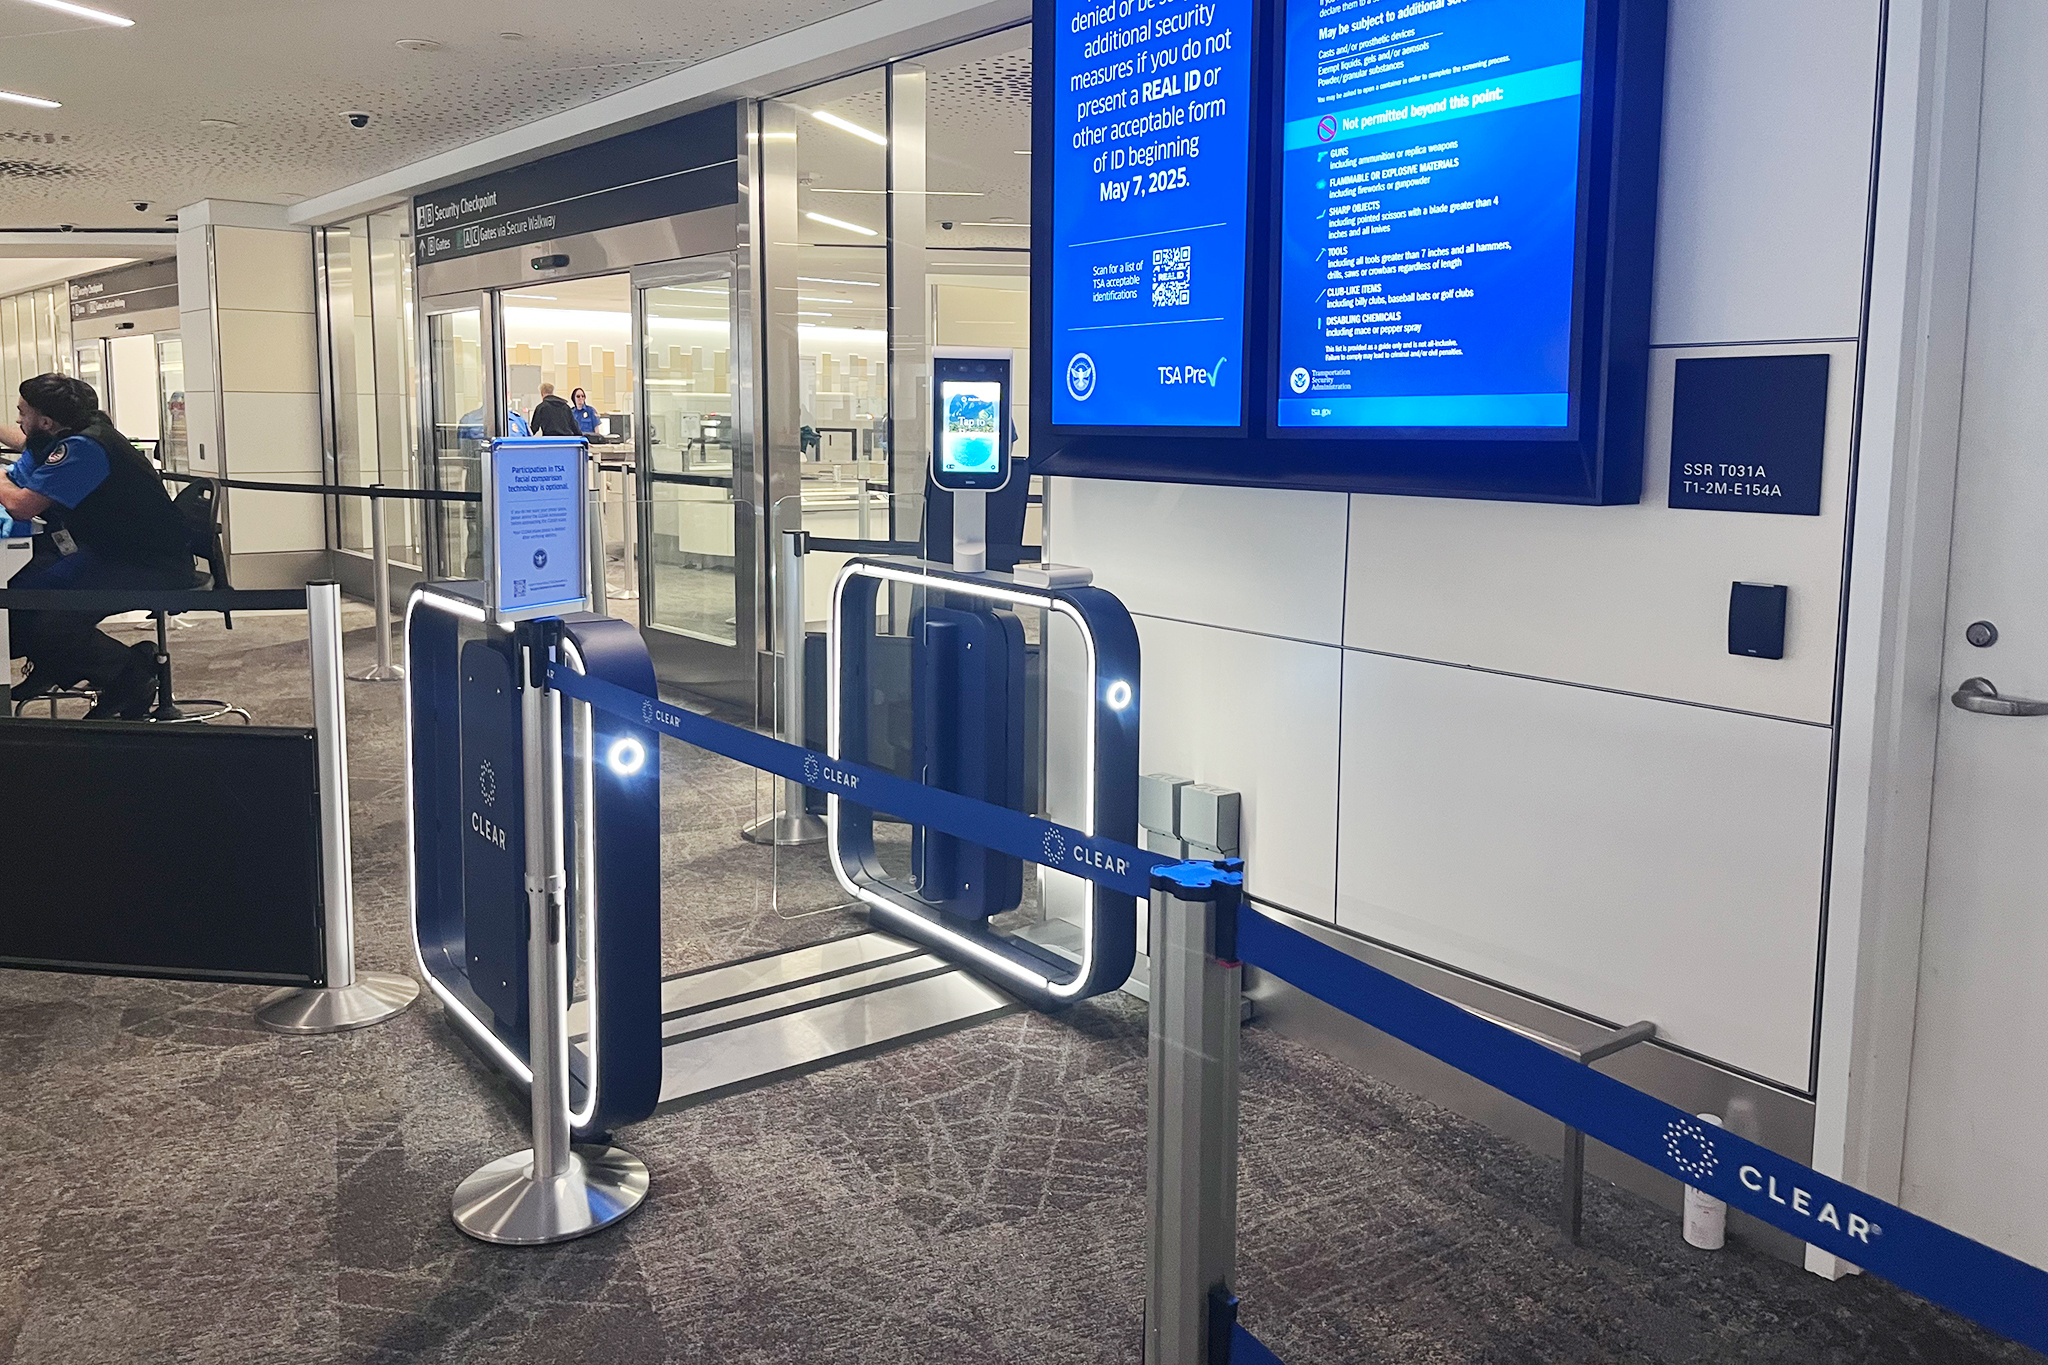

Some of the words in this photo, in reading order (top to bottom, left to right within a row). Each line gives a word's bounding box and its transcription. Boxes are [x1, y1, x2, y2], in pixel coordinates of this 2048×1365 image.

[1071, 0, 1115, 33] denied
[1119, 0, 1134, 18] or
[1319, 5, 1341, 18] declare
[1342, 1, 1358, 12] them
[1319, 27, 1337, 40] May
[1338, 23, 1350, 35] be
[1351, 12, 1384, 31] subject
[1385, 10, 1395, 22] to
[1397, 0, 1445, 19] additional
[1084, 18, 1151, 58] additional
[1155, 4, 1216, 38] security
[1318, 49, 1335, 59] Casts
[1336, 43, 1358, 55] and/or
[1358, 34, 1390, 51] prosthetic
[1391, 28, 1416, 41] devices
[1070, 59, 1133, 92] measures
[1137, 51, 1148, 74] if
[1150, 48, 1178, 73] you
[1181, 38, 1201, 61] do
[1205, 28, 1232, 56] not
[1317, 63, 1340, 76] Exempt
[1340, 58, 1363, 71] liquids,
[1363, 54, 1377, 66] gels
[1377, 49, 1401, 61] and/or
[1401, 41, 1430, 56] aerosols
[1317, 69, 1368, 87] Powder/granular
[1368, 60, 1405, 76] substances
[1077, 88, 1128, 122] present
[1130, 89, 1139, 105] a
[1142, 75, 1181, 103] REAL
[1184, 69, 1201, 93] ID
[1204, 67, 1222, 87] or
[1342, 116, 1359, 131] Not
[1361, 106, 1408, 130] permitted
[1410, 98, 1447, 118] beyond
[1449, 94, 1470, 110] this
[1472, 86, 1504, 109] point:
[1073, 124, 1108, 149] other
[1110, 105, 1185, 140] acceptable
[1188, 98, 1226, 123] form
[1093, 151, 1108, 173] of
[1110, 149, 1125, 170] ID
[1128, 136, 1200, 167] beginning
[1329, 158, 1357, 170] including
[1358, 151, 1396, 165] ammunition
[1396, 150, 1404, 158] or
[1404, 145, 1427, 157] replica
[1427, 140, 1459, 152] weapons
[1330, 146, 1349, 158] GUNS
[1329, 172, 1370, 187] FLAMMABLE
[1370, 170, 1381, 180] OR
[1381, 164, 1418, 179] EXPLOSIVE
[1419, 157, 1459, 173] MATERIALS
[1100, 180, 1130, 202] May
[1132, 175, 1146, 198] 7,
[1149, 166, 1190, 194] 2025.
[1329, 187, 1357, 199] including
[1357, 183, 1385, 195] fireworks
[1386, 182, 1394, 190] or
[1394, 176, 1431, 191] gunpowder
[434, 202, 460, 221] Security
[460, 191, 498, 214] Checkpoint
[1328, 205, 1351, 217] SHARP
[1351, 200, 1380, 213] OBJECTS
[1328, 217, 1356, 228] including
[1356, 213, 1380, 226] pointed
[1381, 210, 1407, 221] scissors
[1407, 207, 1422, 217] with
[1422, 207, 1428, 216] a
[1428, 203, 1448, 214] blade
[1449, 201, 1474, 214] greater
[1475, 198, 1492, 208] than
[1492, 195, 1499, 206] 4
[479, 227, 497, 242] Gates
[497, 224, 506, 237] via
[506, 220, 528, 236] Secure
[527, 215, 556, 230] Walkway
[1328, 230, 1348, 240] inches
[1348, 226, 1361, 237] and
[1362, 225, 1370, 235] all
[1370, 224, 1391, 234] knives
[435, 237, 451, 251] Gates
[1327, 246, 1348, 257] TOOLS
[1327, 258, 1355, 268] including
[1355, 256, 1364, 266] all
[1364, 254, 1381, 264] tools
[1381, 252, 1405, 265] greater
[1404, 250, 1420, 260] than
[1421, 248, 1427, 258] 7
[1427, 247, 1450, 258] inches
[1450, 244, 1465, 255] and
[1465, 243, 1475, 254] all
[1475, 241, 1512, 253] hammers,
[1092, 265, 1108, 276] Scan
[1108, 263, 1118, 274] for
[1119, 265, 1124, 273] a
[1124, 261, 1135, 273] list
[1135, 259, 1144, 271] of
[1327, 270, 1344, 280] drills,
[1344, 269, 1360, 279] saws
[1360, 268, 1368, 277] or
[1368, 265, 1397, 276] crowbars
[1397, 262, 1431, 275] regardless
[1432, 259, 1440, 270] of
[1440, 257, 1463, 270] length
[1092, 278, 1105, 289] TSA
[1105, 274, 1140, 288] acceptable
[1326, 285, 1361, 297] CLUB-LIKE
[1361, 283, 1382, 294] ITEMS
[1092, 288, 1137, 303] identifications
[1326, 298, 1354, 309] including
[1354, 296, 1368, 308] billy
[1368, 295, 1388, 305] clubs,
[1387, 292, 1416, 304] baseball
[1416, 291, 1431, 301] bats
[1432, 292, 1440, 300] or
[1440, 288, 1455, 302] golf
[1455, 287, 1475, 298] clubs
[1326, 314, 1361, 326] DISABLING
[1361, 311, 1402, 324] CHEMICALS
[1326, 327, 1354, 337] including
[1354, 326, 1372, 335] mace
[1372, 326, 1379, 334] or
[1379, 325, 1403, 336] pepper
[1403, 324, 1422, 334] spray
[1158, 366, 1182, 384] TSA
[1184, 365, 1207, 384] Pre
[1311, 369, 1351, 377] Transportation
[1311, 376, 1334, 385] Security
[957, 416, 975, 428] Tap
[976, 419, 986, 427] to
[1311, 408, 1332, 417] tsa.gov
[511, 465, 547, 474] Participation
[515, 475, 530, 483] facial
[530, 475, 562, 483] comparison
[1683, 463, 1713, 476] SSR
[1718, 463, 1766, 478] T031A
[508, 485, 539, 493] technology
[545, 483, 569, 491] optional.
[1683, 481, 1782, 497] T1-2M-E154A
[471, 811, 507, 851] CLEAR
